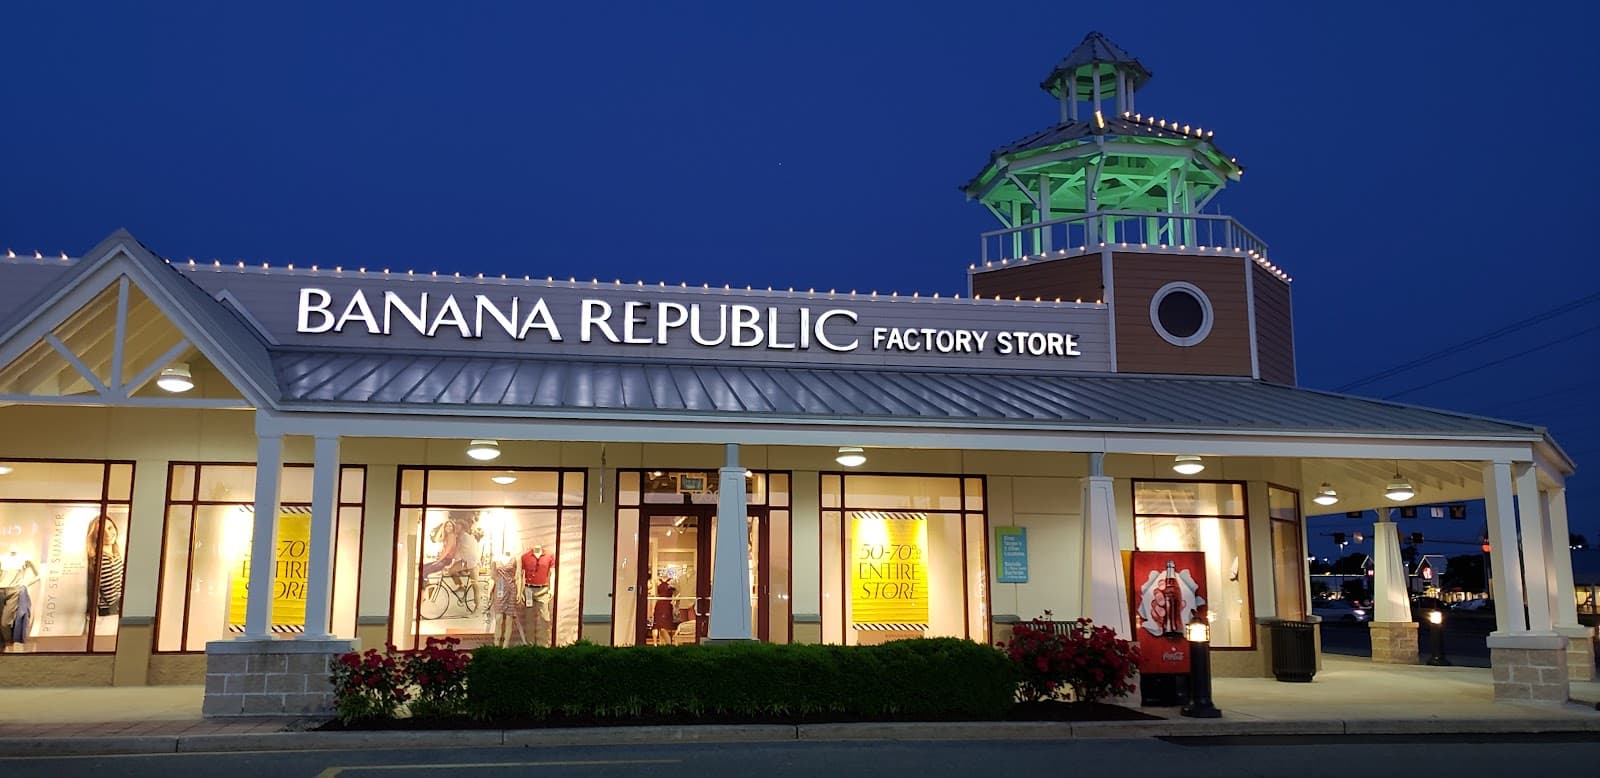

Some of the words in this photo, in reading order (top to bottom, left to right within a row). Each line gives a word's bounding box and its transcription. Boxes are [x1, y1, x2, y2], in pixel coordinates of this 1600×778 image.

[296, 288, 562, 342] BANANA
[580, 299, 859, 352] REPUBLIC
[872, 327, 986, 353] FACTORY
[997, 331, 1082, 356] STORE
[859, 562, 920, 580] ENTIRE
[860, 582, 920, 599] STORE
